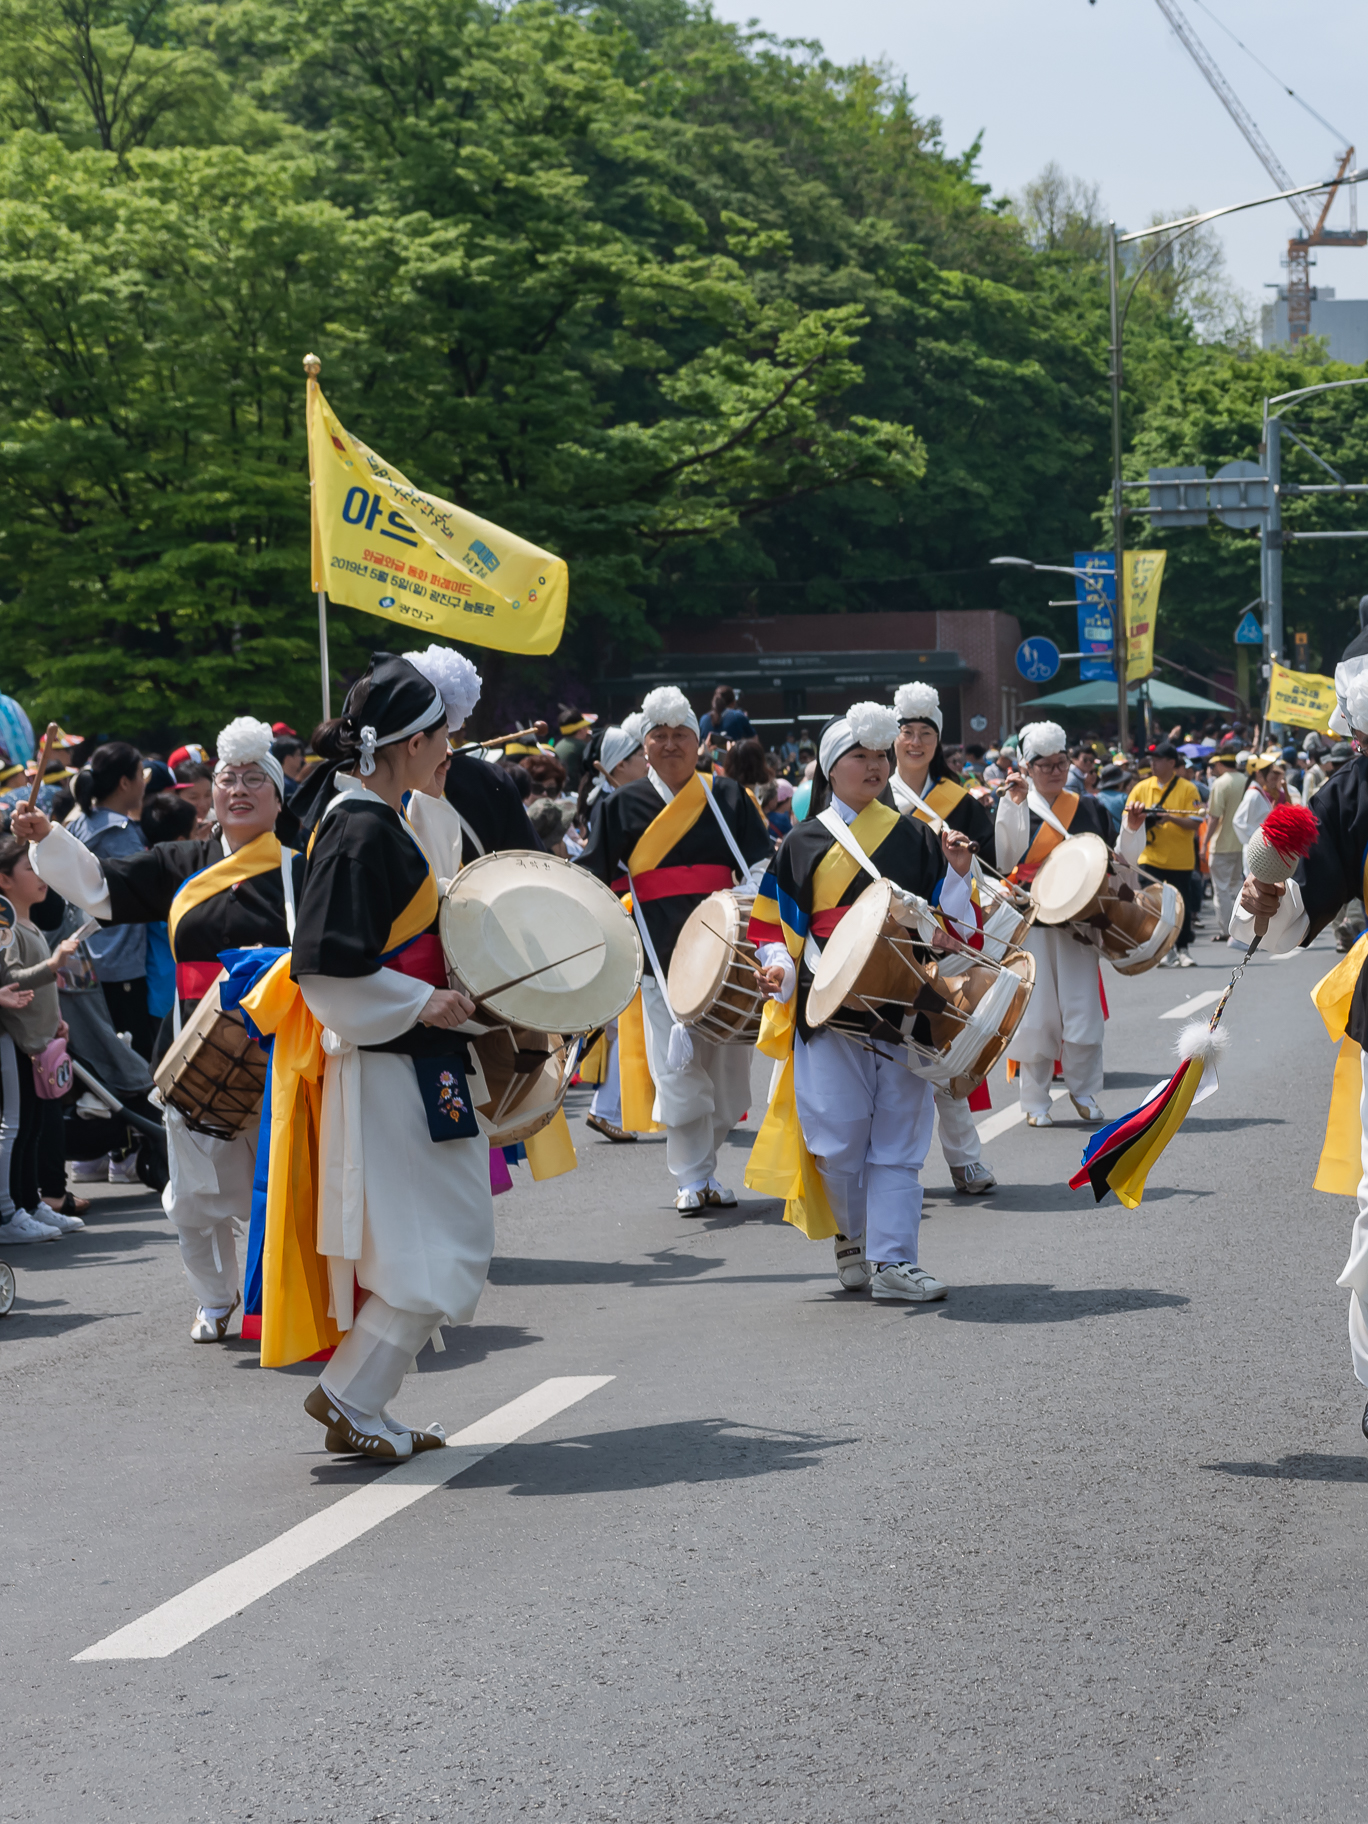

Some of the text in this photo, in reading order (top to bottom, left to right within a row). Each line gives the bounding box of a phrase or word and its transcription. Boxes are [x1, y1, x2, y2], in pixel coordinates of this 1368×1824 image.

[330, 556, 496, 618] 2019년 5월 5일(일) 광진구 능동로
[361, 548, 473, 597] 와글와글 동화 퍼레이드
[398, 602, 434, 622] 광진구
